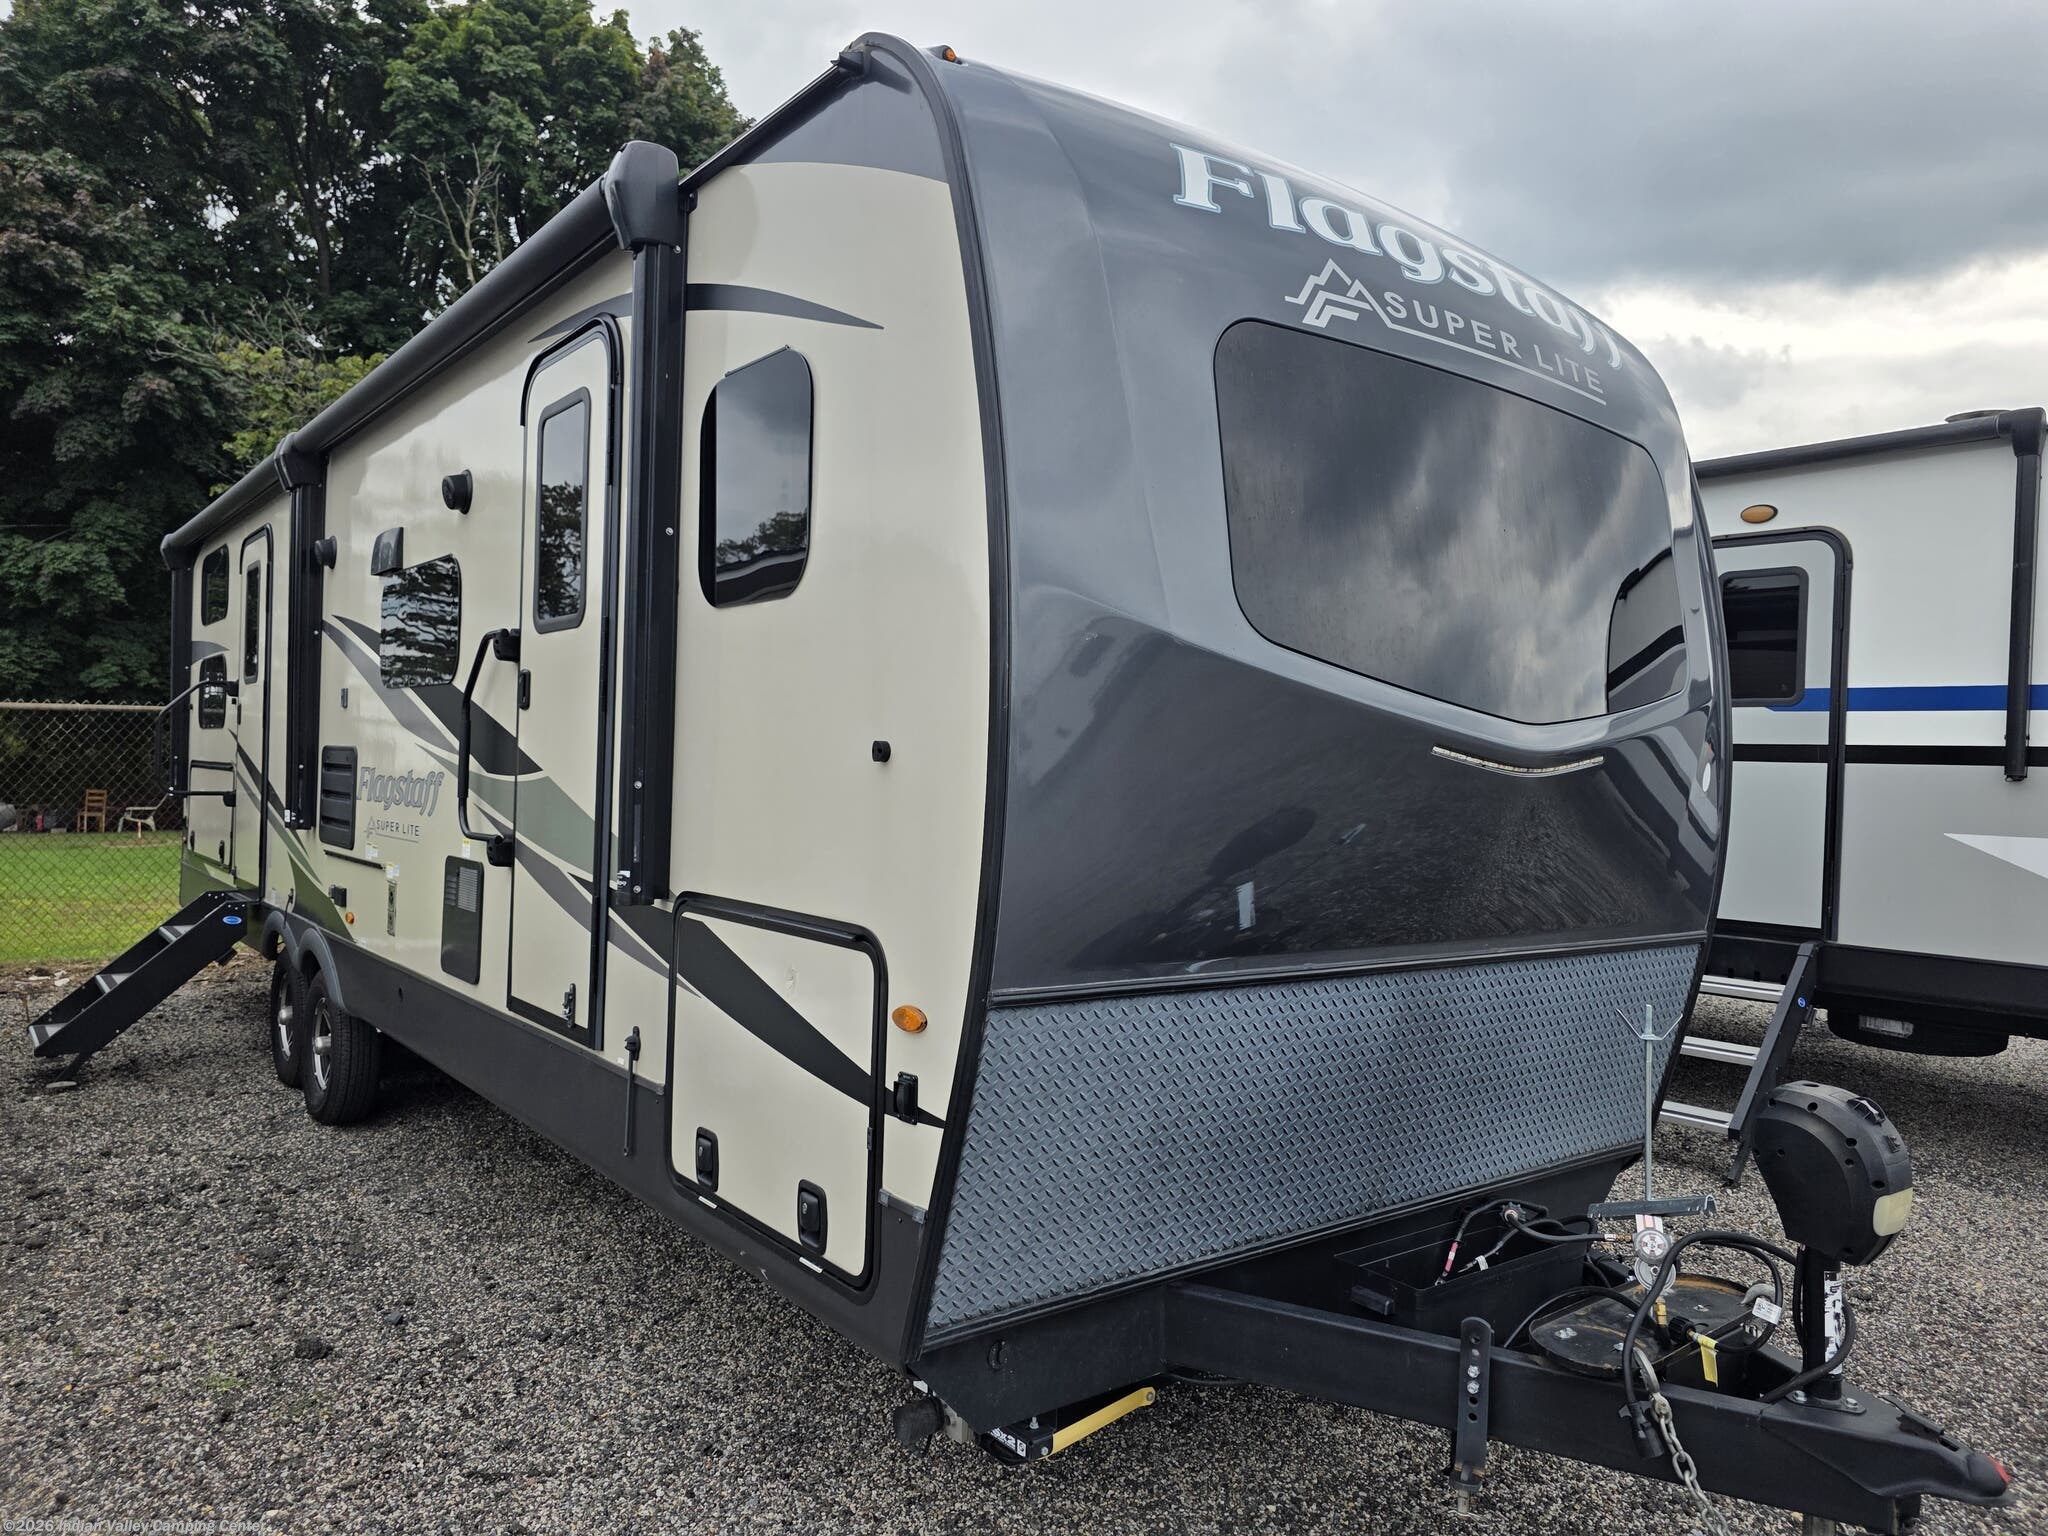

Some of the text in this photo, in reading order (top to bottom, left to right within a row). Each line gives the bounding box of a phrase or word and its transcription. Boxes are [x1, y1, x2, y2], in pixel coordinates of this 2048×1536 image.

[1383, 291, 1604, 394] SUPER LITE
[356, 766, 445, 817] Flagstaff
[376, 819, 420, 837] SUPER LITE
